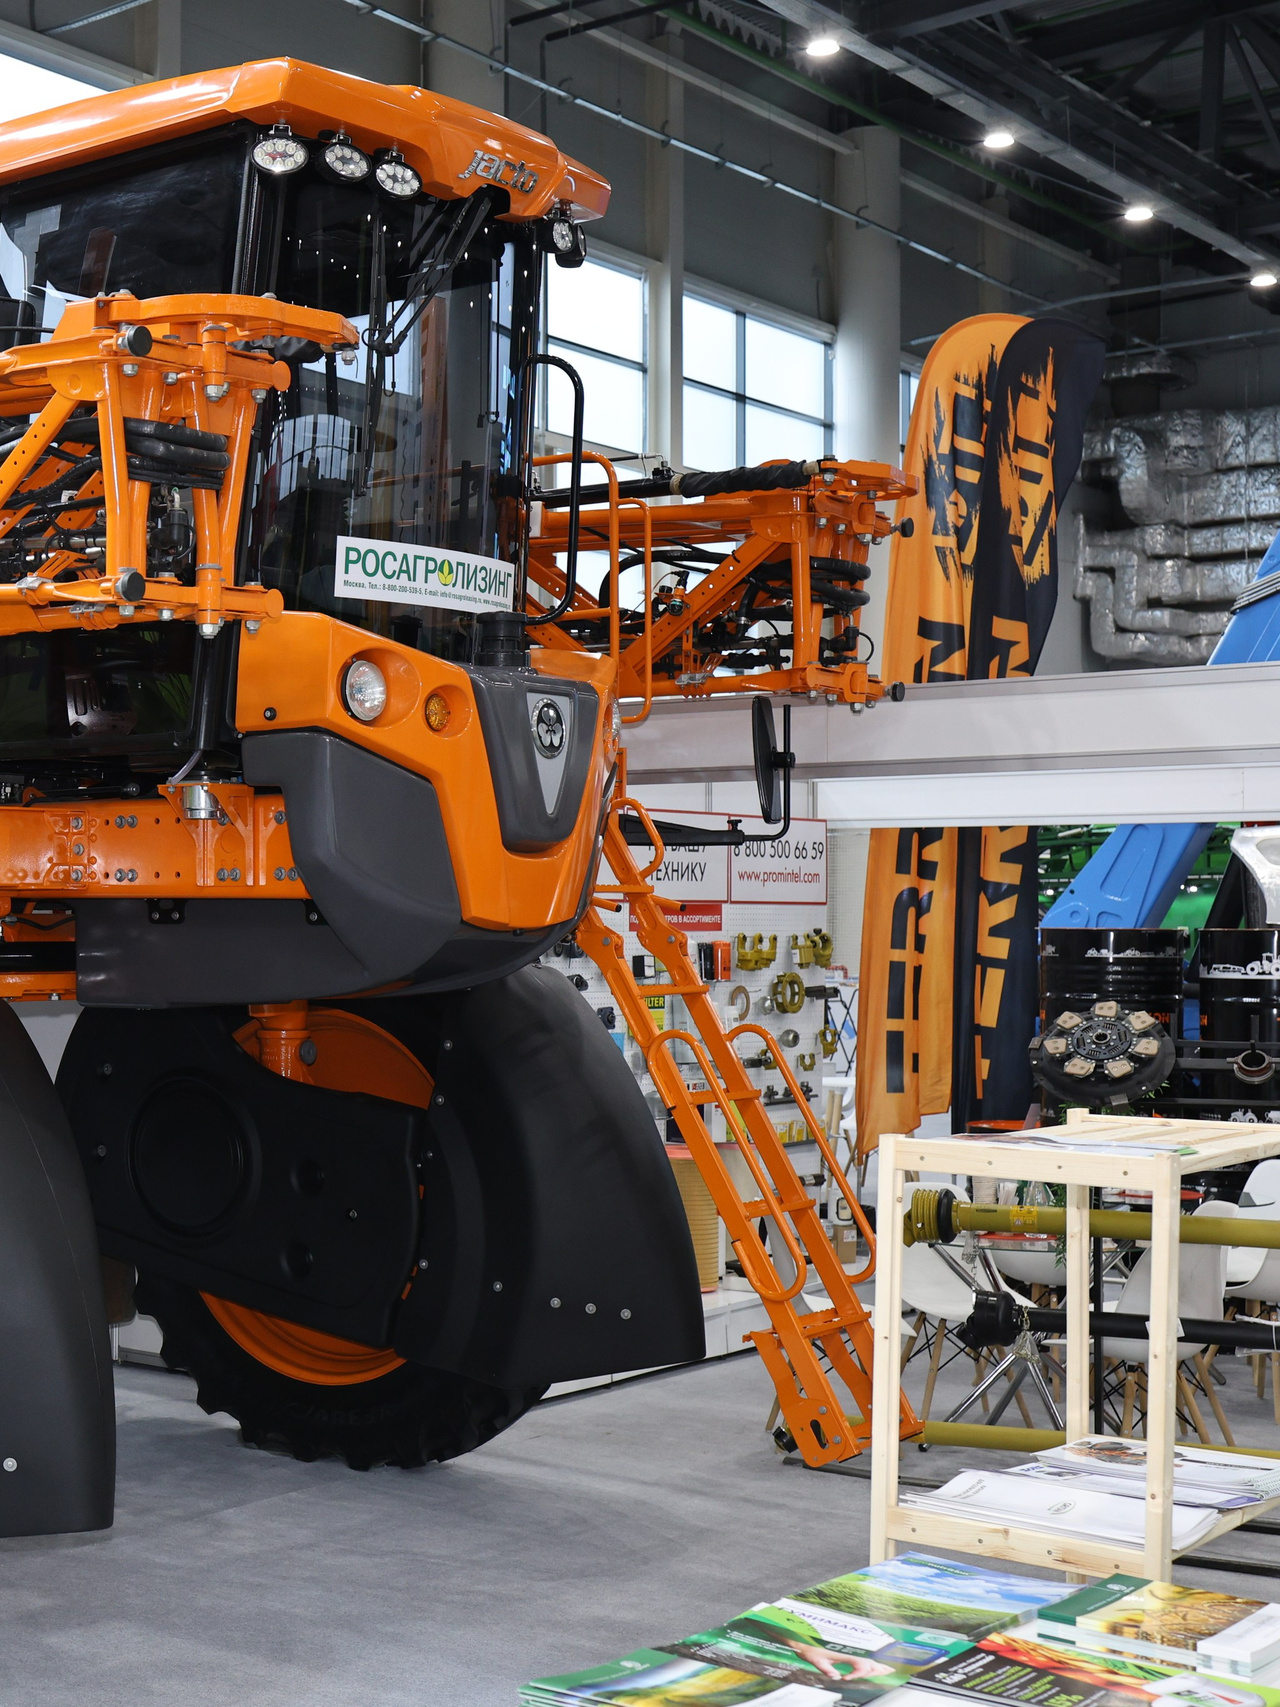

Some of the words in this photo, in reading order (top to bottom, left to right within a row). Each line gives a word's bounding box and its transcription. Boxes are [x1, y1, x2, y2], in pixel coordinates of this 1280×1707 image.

[344, 546, 512, 599] РОСАГРОЛИЗИНГ
[344, 580, 367, 589] Москва,
[368, 582, 382, 590] Тел.:
[424, 588, 440, 597] E-mail:
[745, 841, 766, 858] 800
[769, 840, 791, 859] 500
[794, 841, 808, 859] 66
[811, 842, 824, 860] 59
[737, 866, 821, 887] www.promintel.com
[683, 915, 721, 924] АССОРТИМЕНТЕ
[644, 997, 664, 1007] ILTER
